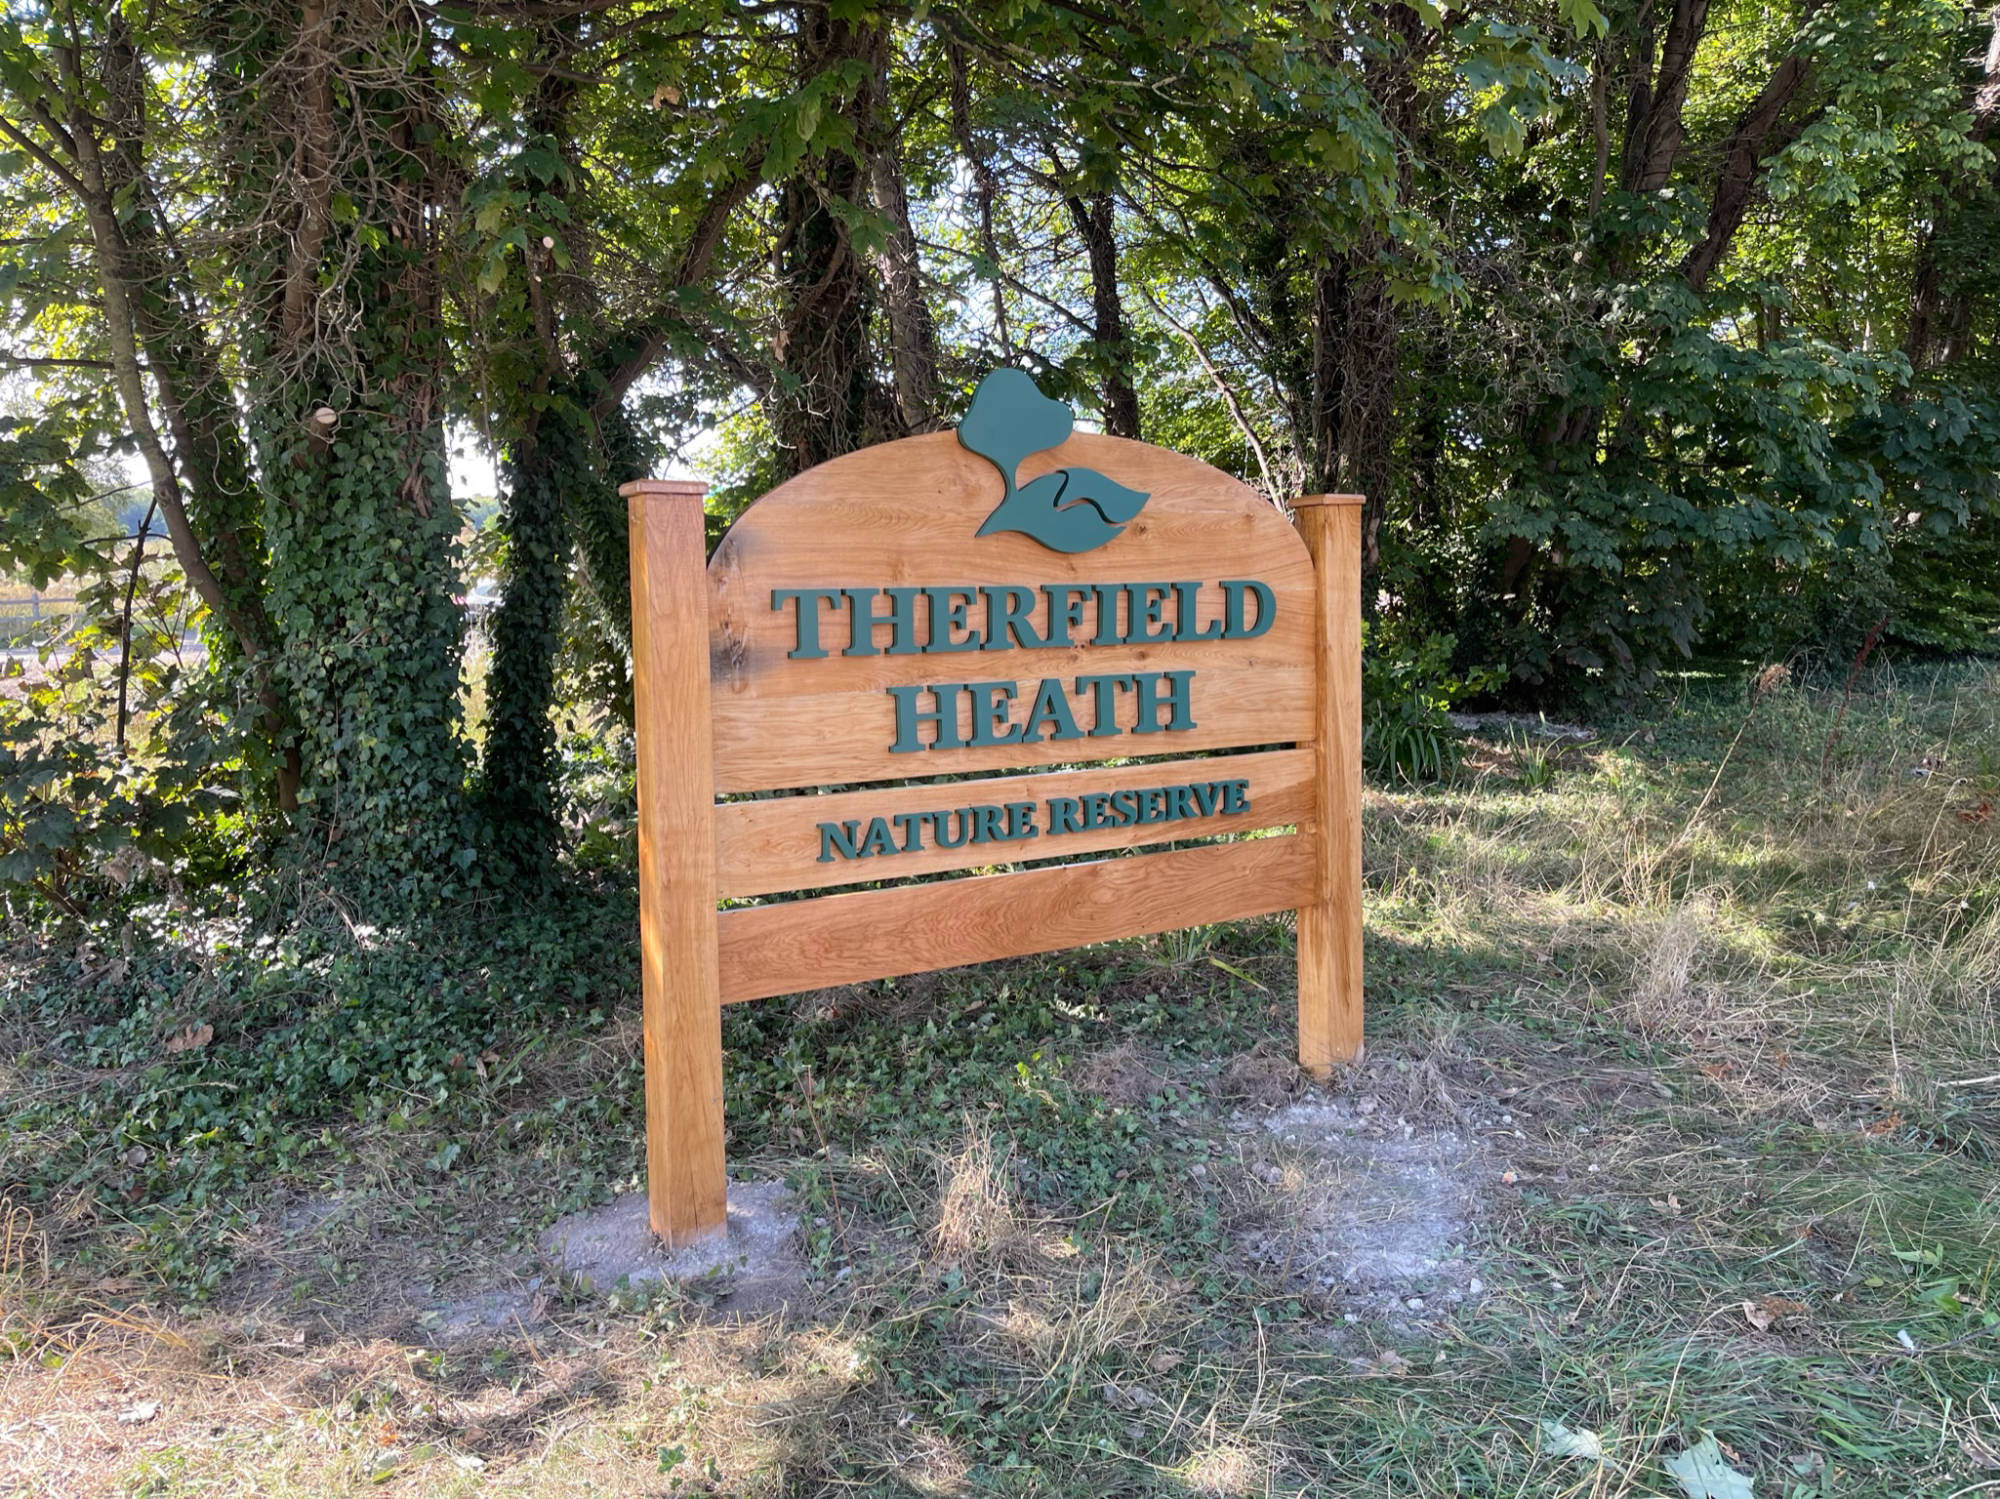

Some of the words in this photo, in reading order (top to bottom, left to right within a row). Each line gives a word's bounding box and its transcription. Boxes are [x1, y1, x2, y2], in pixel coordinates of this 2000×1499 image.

[771, 580, 1277, 659] THERFIELD
[887, 670, 1197, 754] HEATH
[816, 801, 1038, 863] NATURE
[1046, 779, 1251, 835] RESERVE
